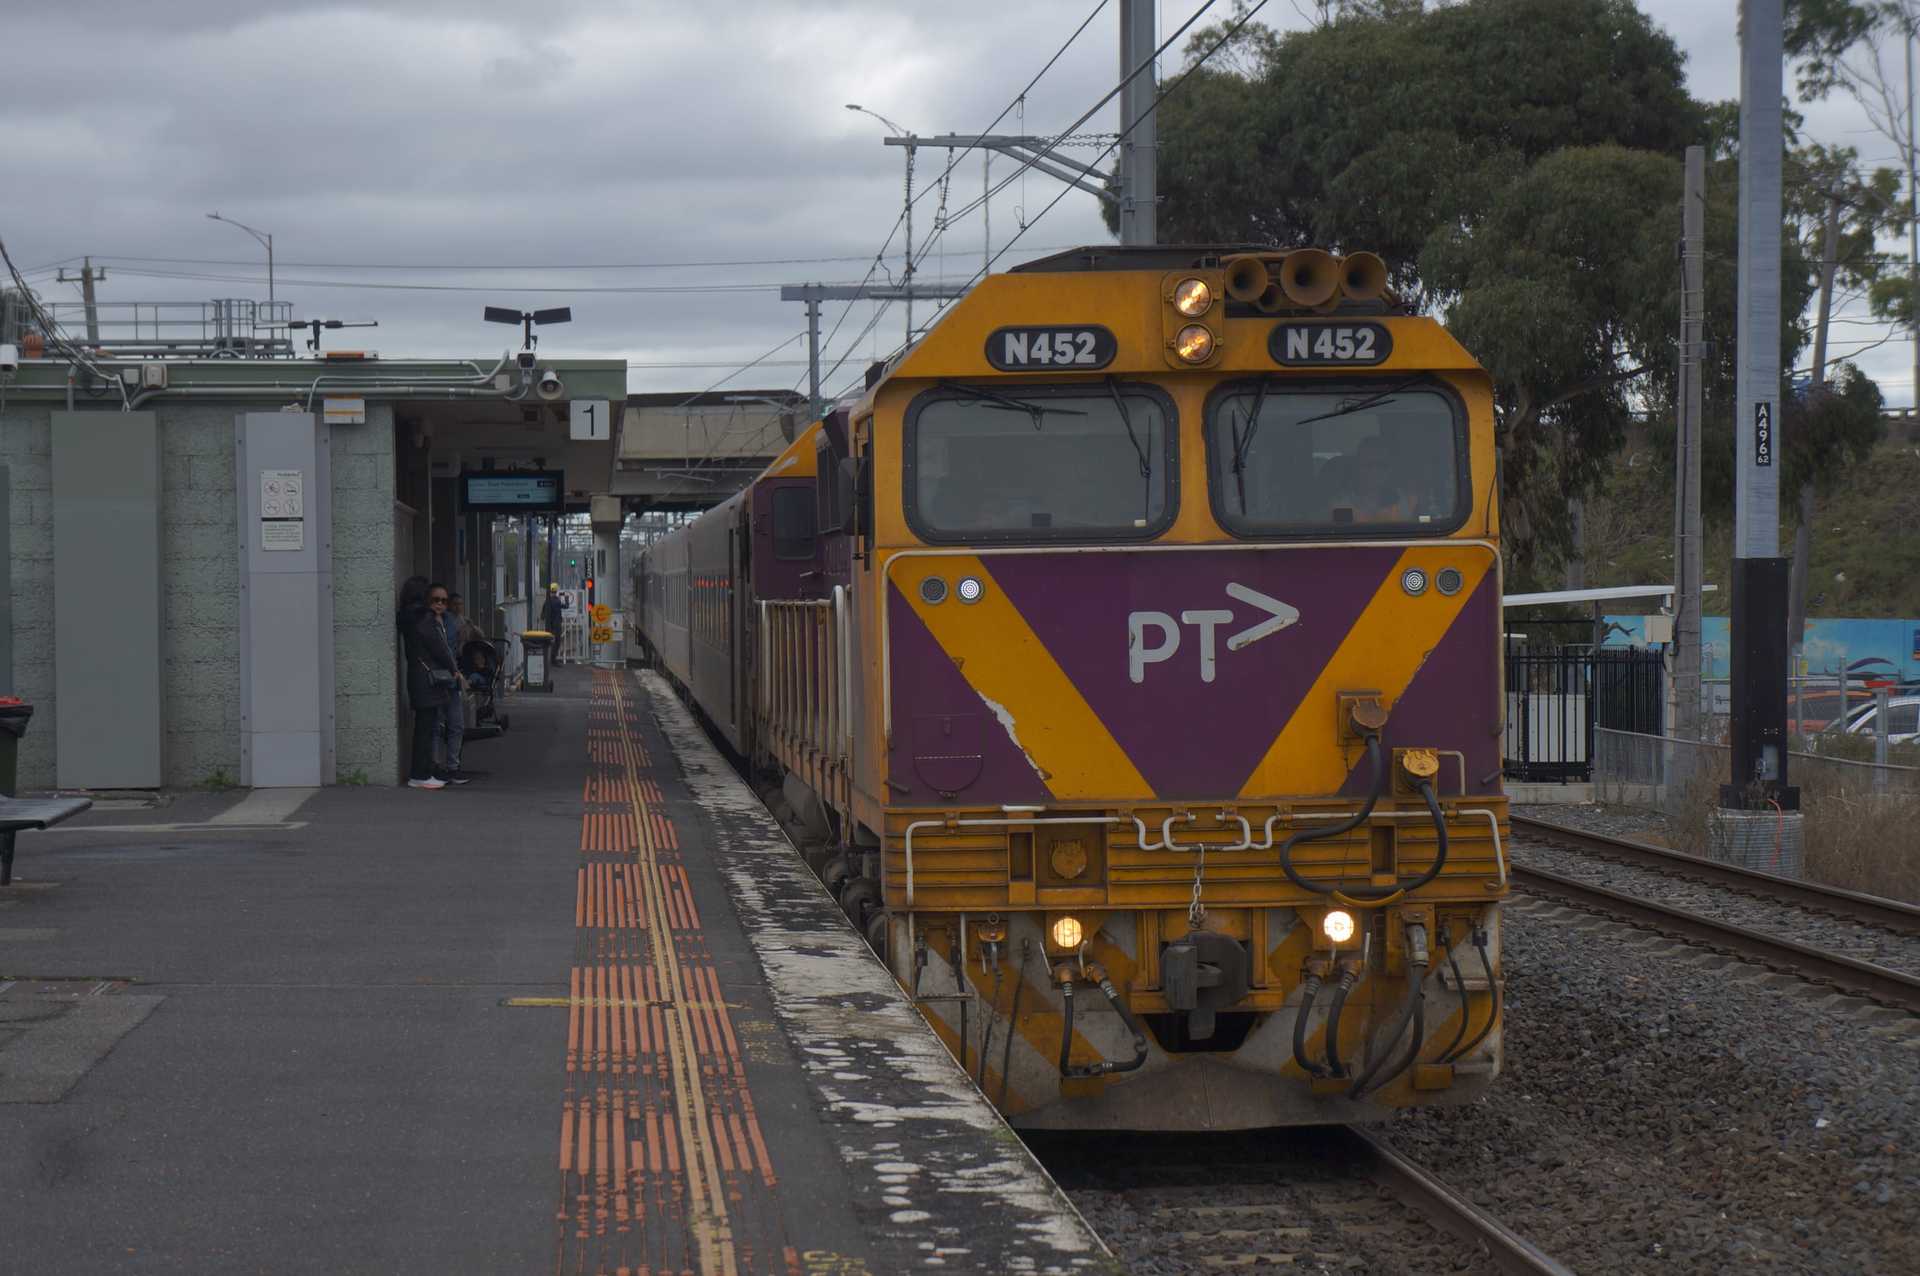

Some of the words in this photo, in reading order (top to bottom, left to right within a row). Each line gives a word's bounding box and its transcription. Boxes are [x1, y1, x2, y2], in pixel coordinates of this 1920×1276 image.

[1004, 331, 1097, 365] N452
[1287, 327, 1376, 359] N452
[582, 404, 595, 437] 1
[593, 627, 610, 642] 65
